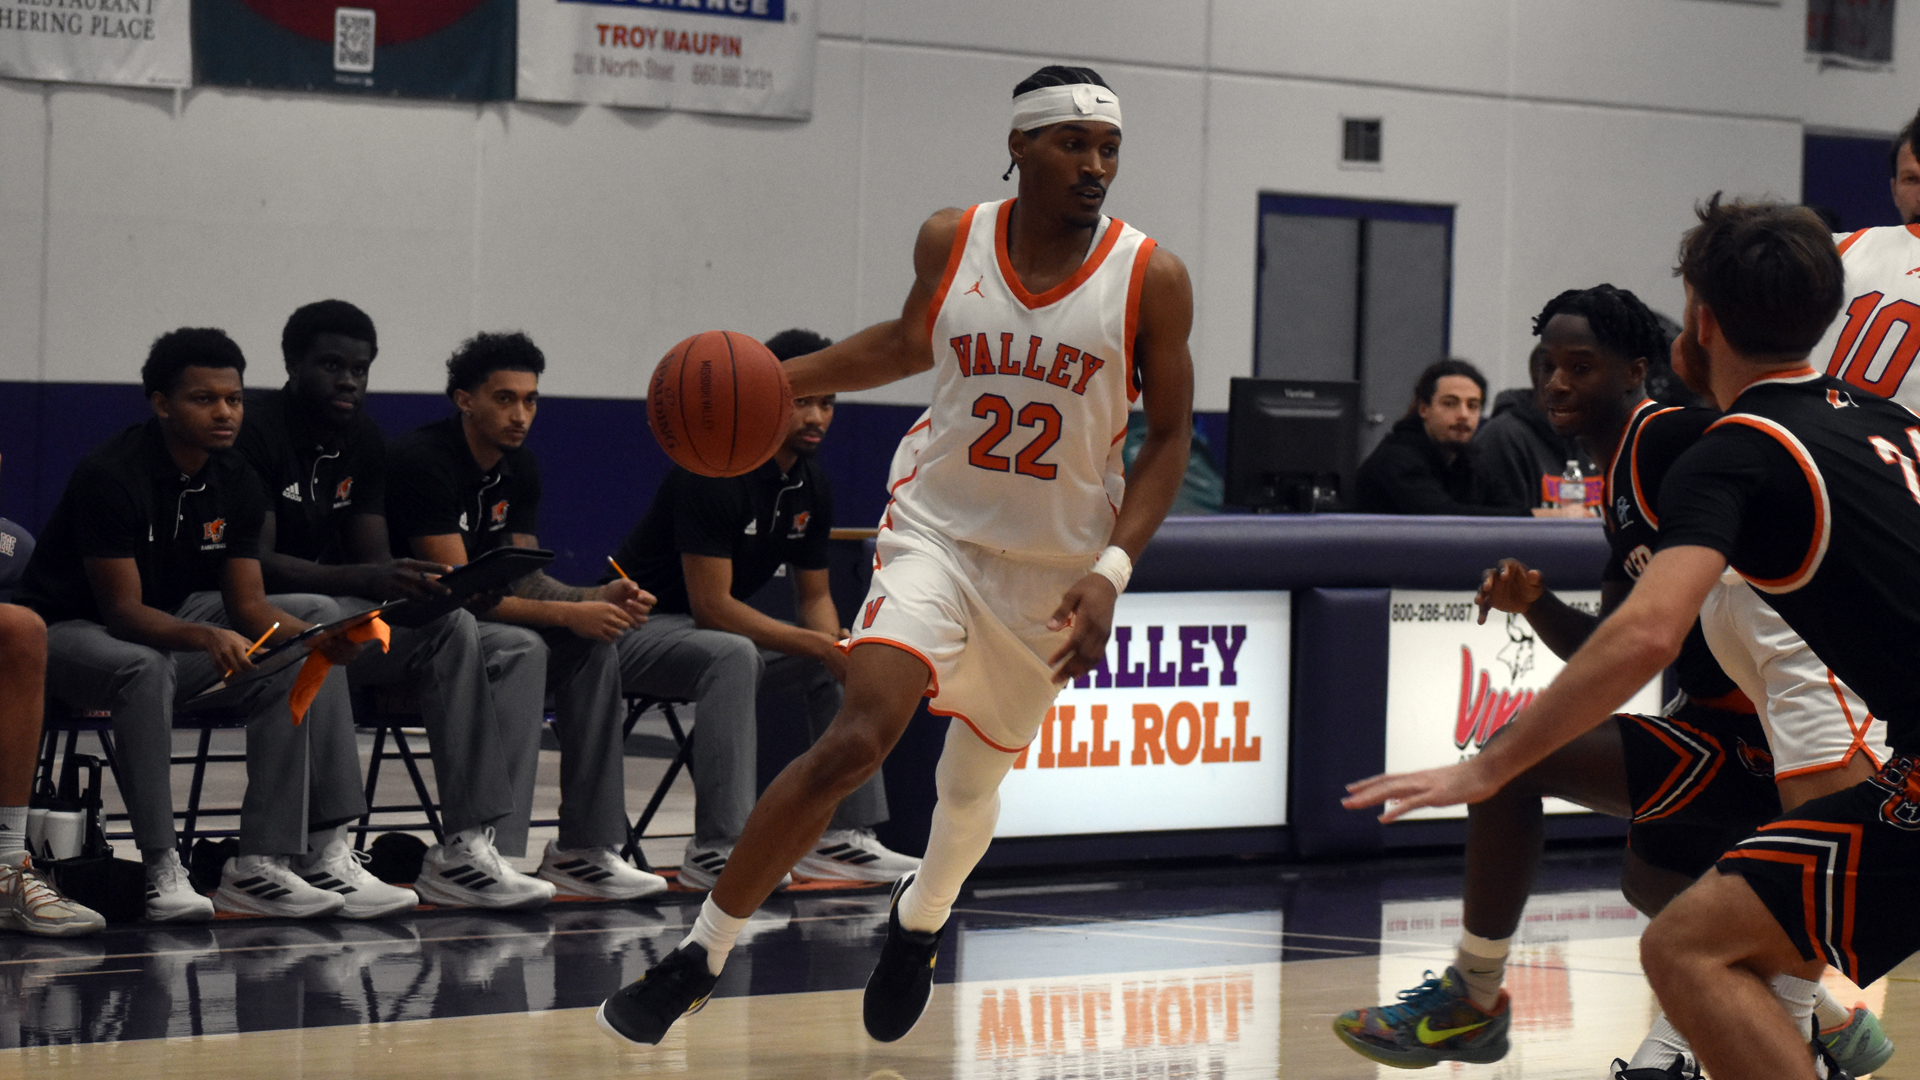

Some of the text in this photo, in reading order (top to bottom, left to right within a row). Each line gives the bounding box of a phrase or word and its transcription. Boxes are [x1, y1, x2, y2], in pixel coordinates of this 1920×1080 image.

[90, 15, 156, 40] PLACE
[596, 24, 742, 57] TROY MAUPIN
[949, 332, 1106, 396] VALLEY
[1826, 290, 1920, 399] 10
[701, 360, 715, 431] MISSOURI VALLEY
[968, 392, 1063, 481] 22
[1392, 602, 1473, 622] 800-286-0087
[1062, 624, 1248, 689] LLEY
[1131, 700, 1262, 767] ROLL
